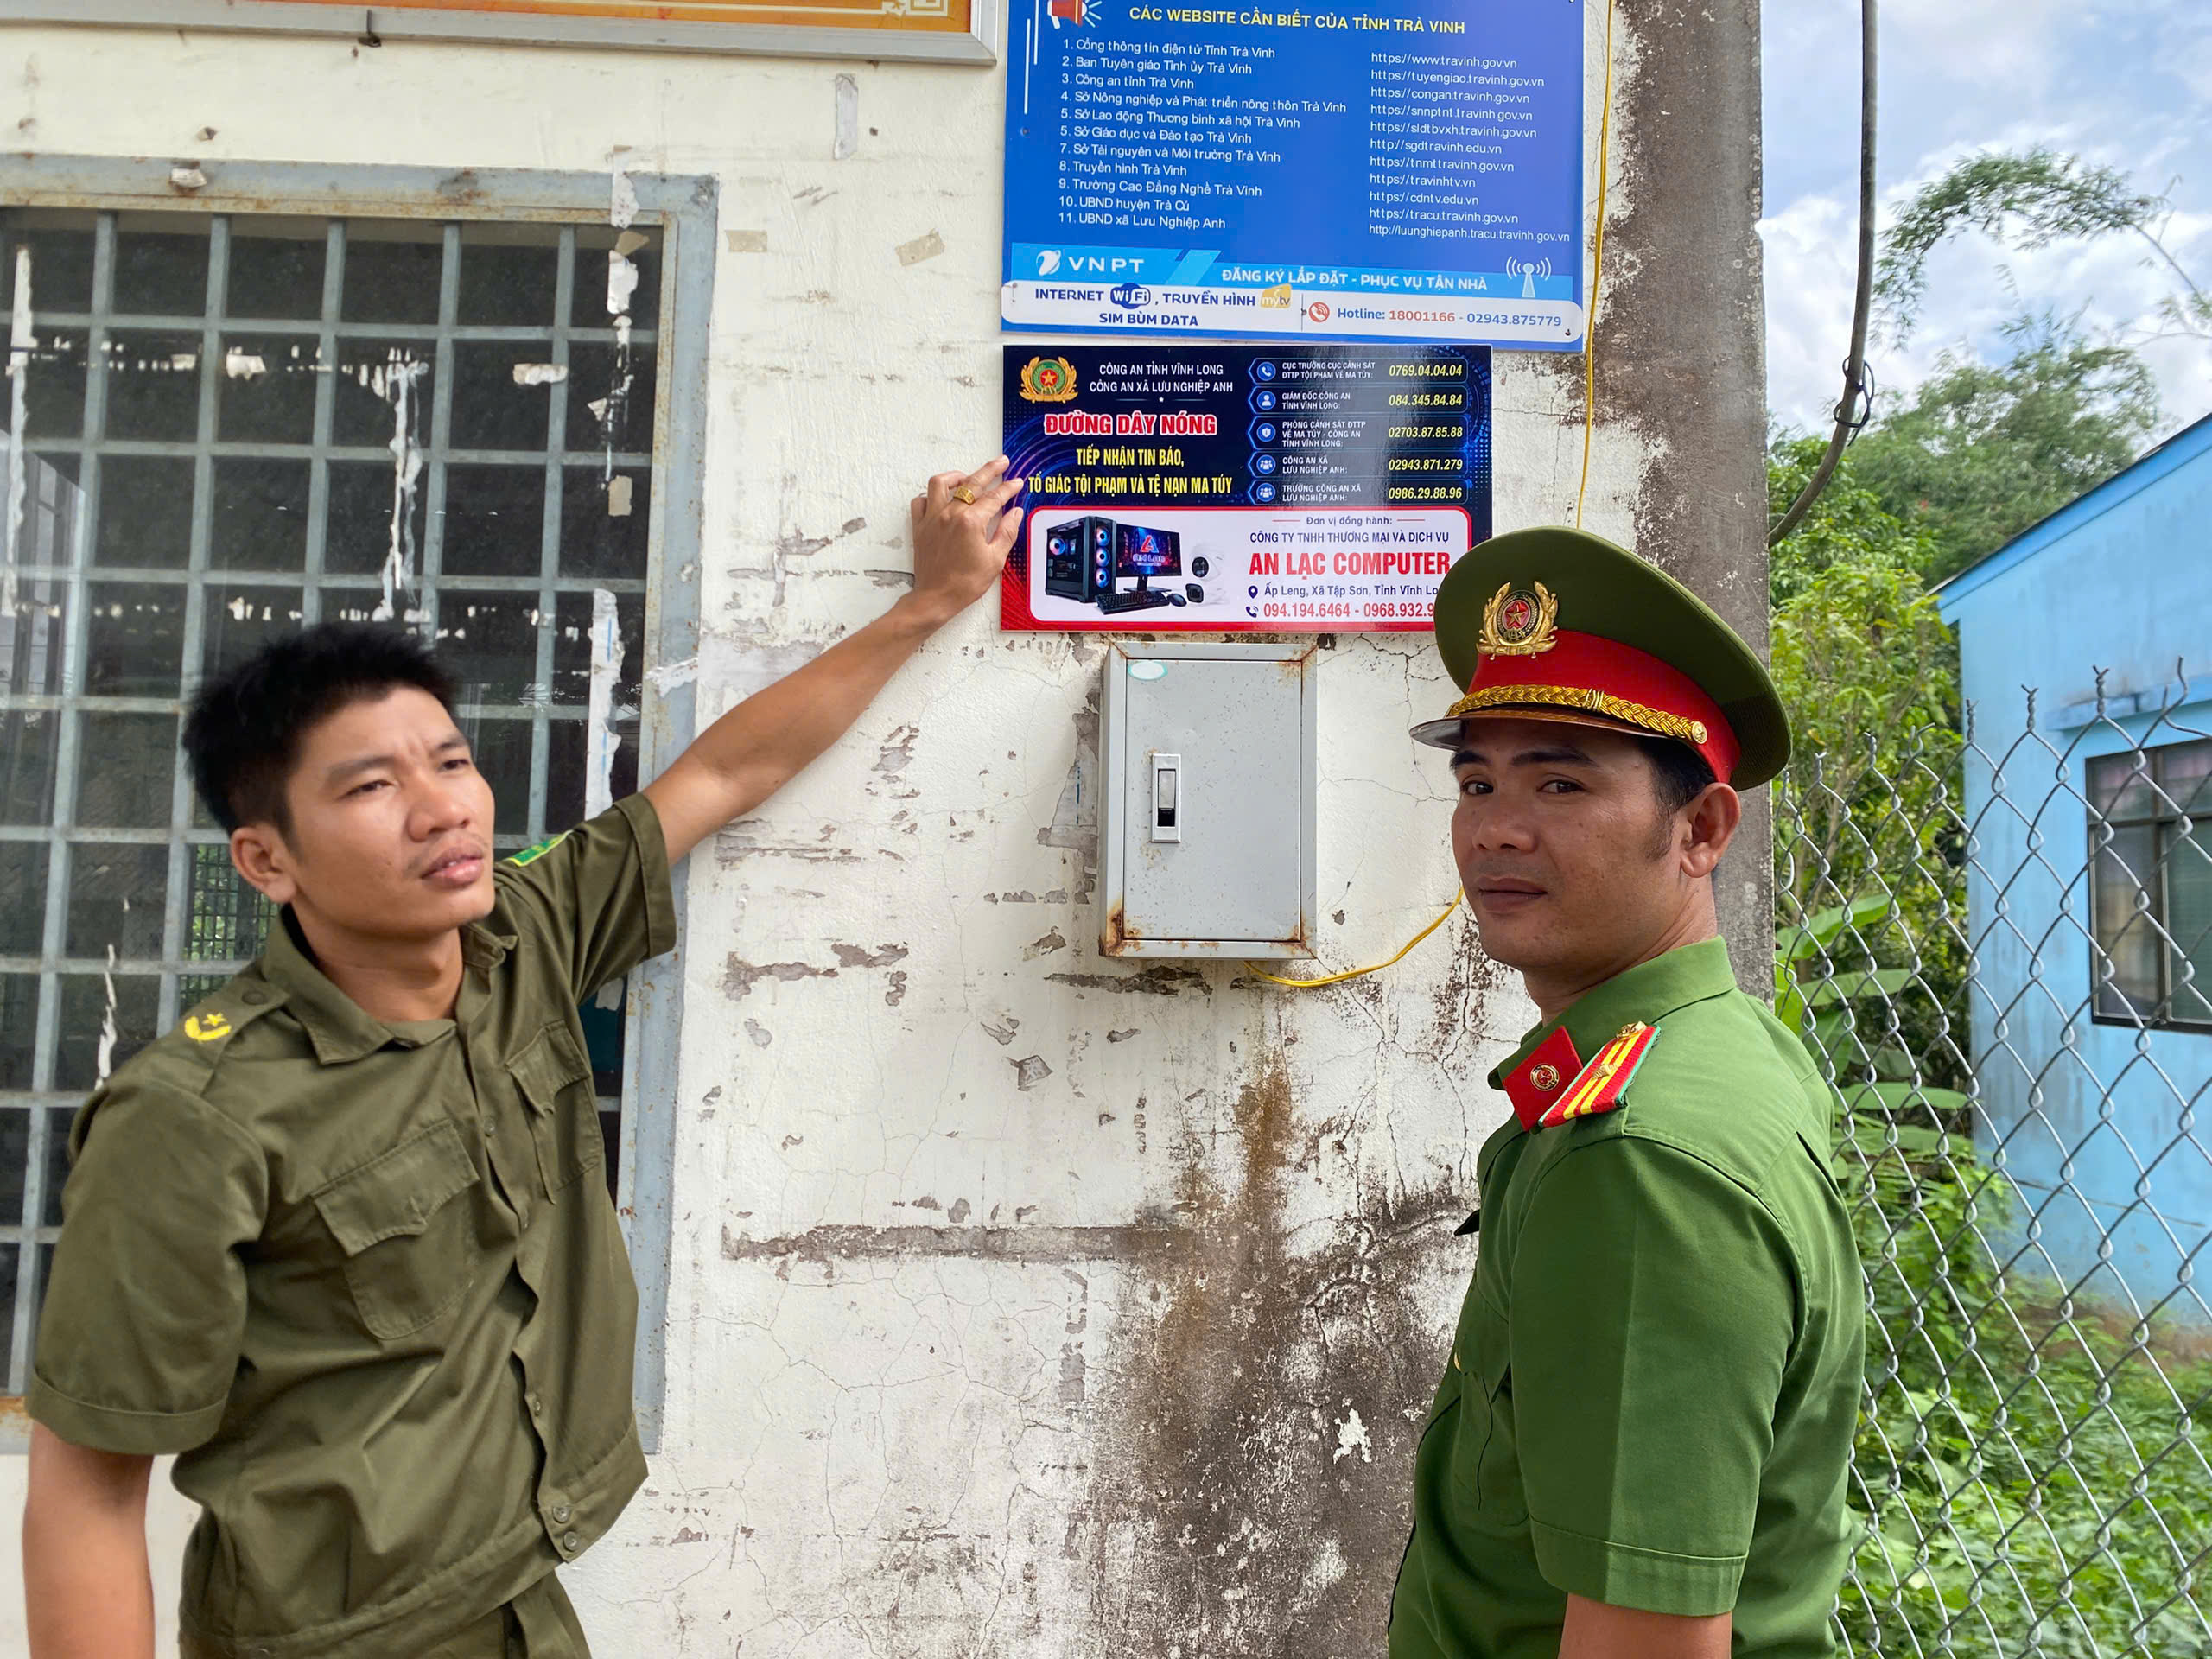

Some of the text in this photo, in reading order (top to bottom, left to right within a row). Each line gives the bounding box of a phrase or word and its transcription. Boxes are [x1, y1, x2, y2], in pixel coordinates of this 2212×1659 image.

[1129, 5, 1465, 34] CÁC WEBSITE CẦN BIẾT CỦA TỈNH TRÀ VINH
[1109, 41, 1275, 58] thông tin Trà Vinh
[1077, 57, 1252, 74] Ban Tuyên giáo Trà Vinh
[1075, 73, 1103, 87] Công
[1149, 77, 1166, 87] Trà
[1170, 78, 1194, 89] Vinh
[1093, 92, 1346, 112] Nông Phát nông thôn Trà Vinh
[1092, 109, 1300, 128] Lao động Trà Vinh
[1120, 128, 1251, 143] dục tạo Vinh
[1111, 146, 1281, 162] nguyên Vinh
[1072, 160, 1186, 176] Truyền Trà Vinh
[1119, 181, 1262, 196] Cao Trà Vinh
[1080, 197, 1172, 212] UBND huyện Trà
[1079, 213, 1225, 230] UBND xã Lưu Nghiệp Anh
[1068, 257, 1145, 274] VNPT
[1222, 267, 1487, 291] ĐĂNG KÝ LẮP ĐẶT PHỤC VỤ TẬN NHÀ
[1035, 289, 1104, 302] INTERNET
[1163, 289, 1218, 305] TRUYỀN
[1223, 291, 1255, 307] HÌNH
[1099, 311, 1198, 326] SIM BÙM DATA
[1338, 308, 1561, 327] Hotline: 18001166 02943.875779
[1099, 360, 1224, 375] CÔNG AN TỈNH VĨNH LONG
[1389, 365, 1463, 377] 0769.04.04.04
[1090, 378, 1234, 396] CÔNG AN XÃ LƯU NGHIỆP ANH
[1319, 391, 1338, 400] CÔNG
[1389, 394, 1463, 406] 084.345.84.84
[1044, 410, 1217, 435] ĐƯỜNG DÂY NÓNG
[1389, 426, 1463, 438] 02703.87.85.88
[1077, 443, 1185, 469] TIẾP NHẬN TIN BÁO,
[1282, 455, 1304, 464] CÔNG
[1389, 459, 1463, 471] 02943.871.279
[1028, 470, 1233, 498] TỐ GIÁC TỘI PHẠM VÀ TỆ NẠN MA TÚY
[1316, 484, 1337, 493] CÔNG
[1389, 487, 1463, 499] 0986.29.88.96
[1306, 514, 1393, 527] Đơn vị đồng hành:
[1250, 529, 1449, 544] CÔNG TY TNHH THƯƠNG MẠI VÀ DỊCH VỤ
[1249, 551, 1451, 580] AN LẠC COMPUTER
[1264, 582, 1439, 598] Ấp Leng, Xã Tập Sơn, Tỉnh Vĩnh Lo
[1264, 602, 1434, 618] 094.194.6464 0968.932.9
